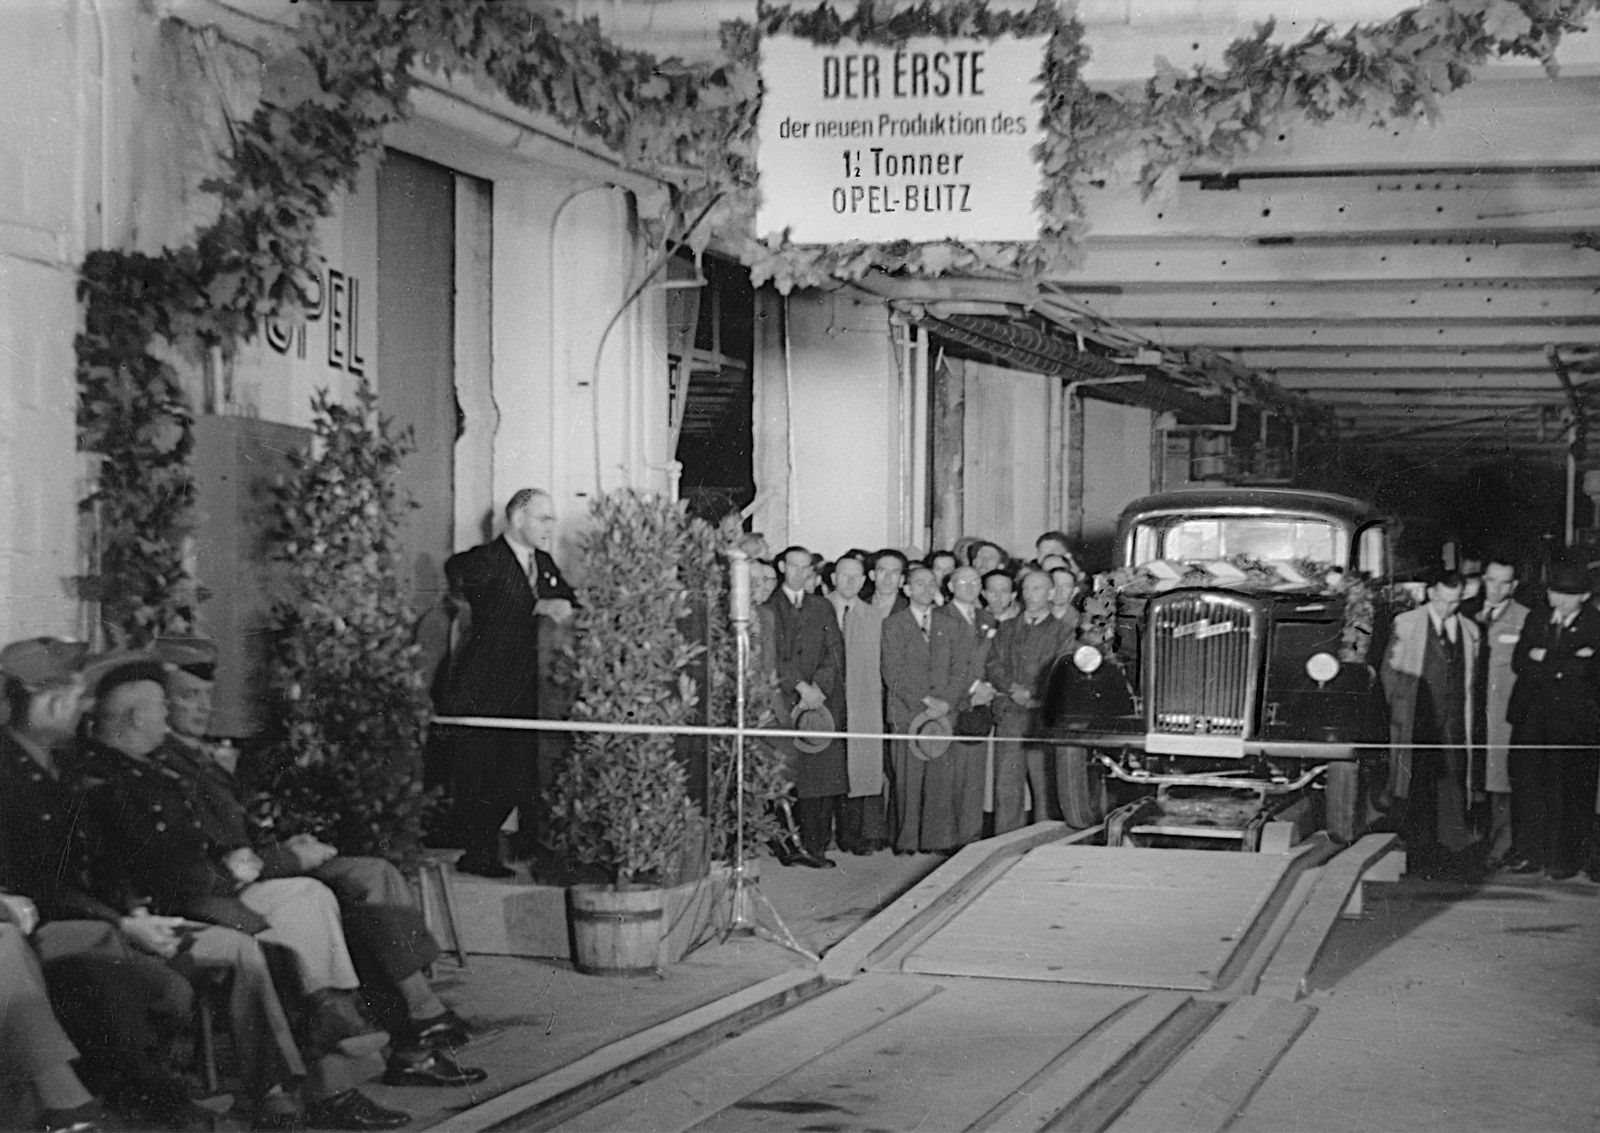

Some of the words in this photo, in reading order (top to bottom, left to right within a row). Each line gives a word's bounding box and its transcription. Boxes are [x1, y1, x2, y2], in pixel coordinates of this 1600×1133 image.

[822, 53, 881, 99] DER
[893, 51, 985, 98] ERSTE
[779, 117, 811, 139] der
[815, 118, 873, 138] neuen
[878, 113, 986, 137] Produktion
[991, 112, 1027, 135] des
[869, 148, 964, 176] Tonner
[831, 183, 973, 214] OPEL-BLITZ
